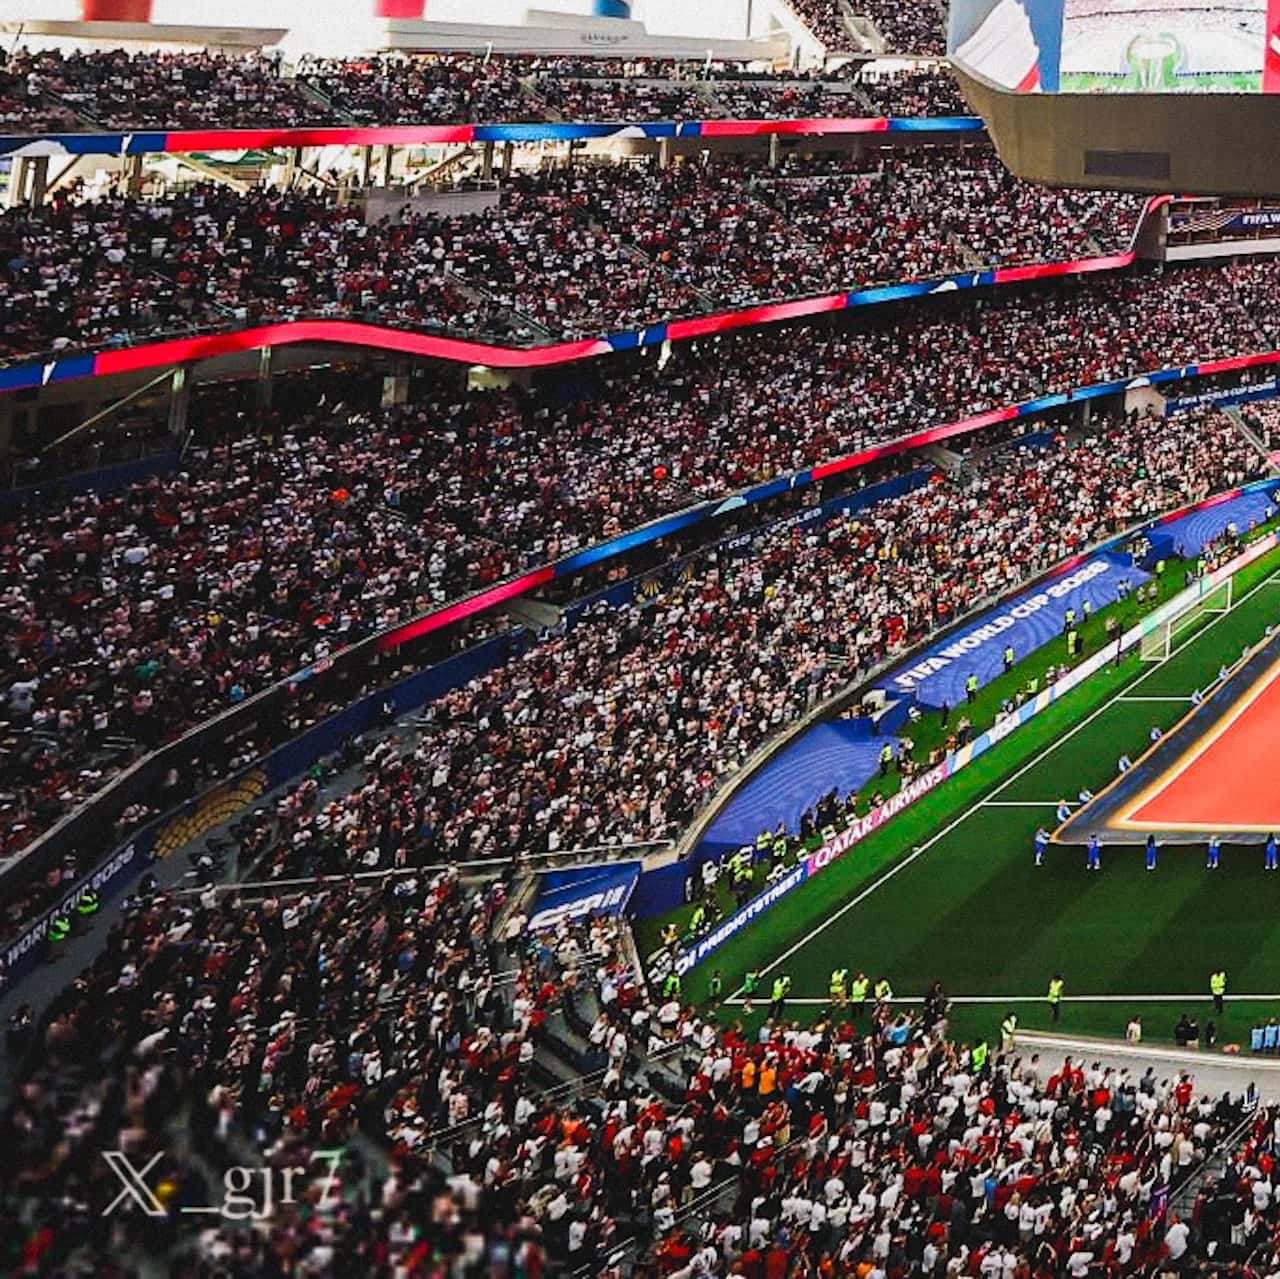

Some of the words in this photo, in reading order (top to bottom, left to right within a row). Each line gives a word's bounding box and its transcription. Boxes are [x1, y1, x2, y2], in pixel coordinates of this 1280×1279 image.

[1242, 213, 1270, 225] FIFA
[894, 657, 951, 687] FIFA
[938, 616, 1016, 659] WORLD
[1010, 594, 1050, 619] CUP
[1046, 560, 1110, 598] 2026
[814, 817, 875, 868] QATAR
[876, 770, 944, 824] AIRWAYS
